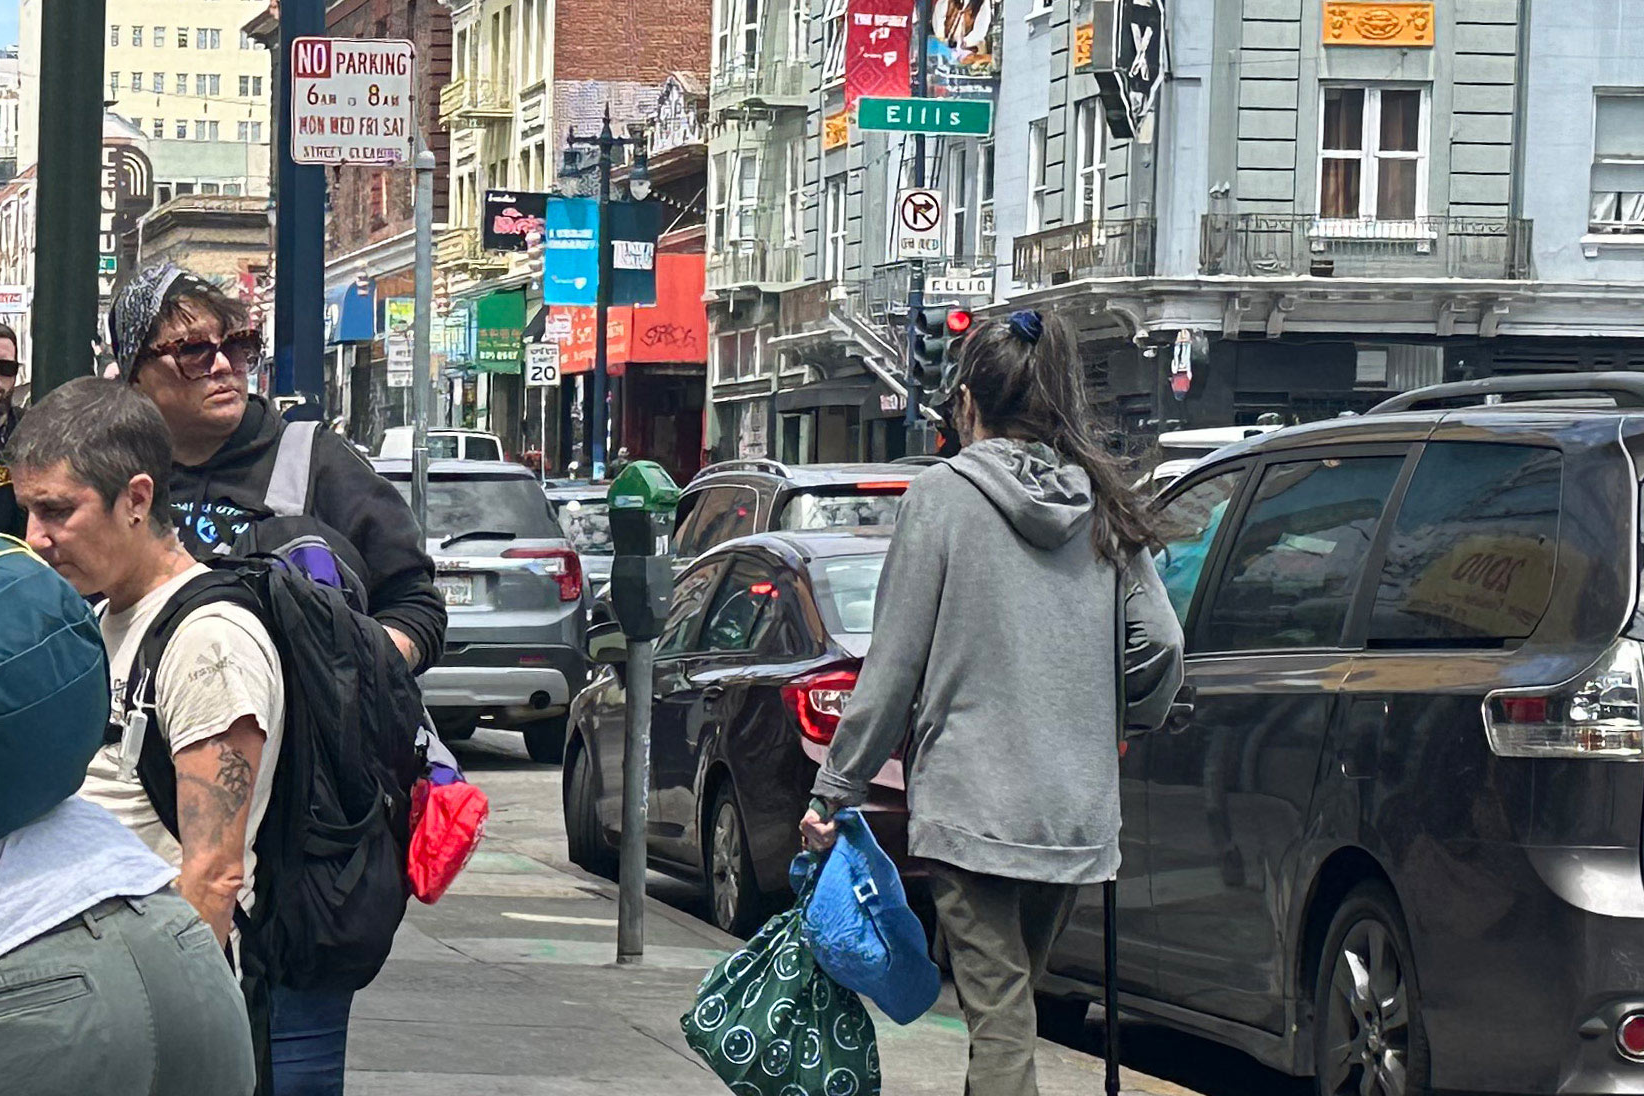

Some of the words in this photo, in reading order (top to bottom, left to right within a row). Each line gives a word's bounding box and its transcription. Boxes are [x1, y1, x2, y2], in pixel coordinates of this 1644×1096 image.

[298, 43, 327, 74] NO
[336, 52, 407, 76] PARKING
[299, 116, 325, 135] MON
[359, 117, 378, 136] FRI
[383, 117, 405, 137] SAT
[530, 365, 556, 381] 20
